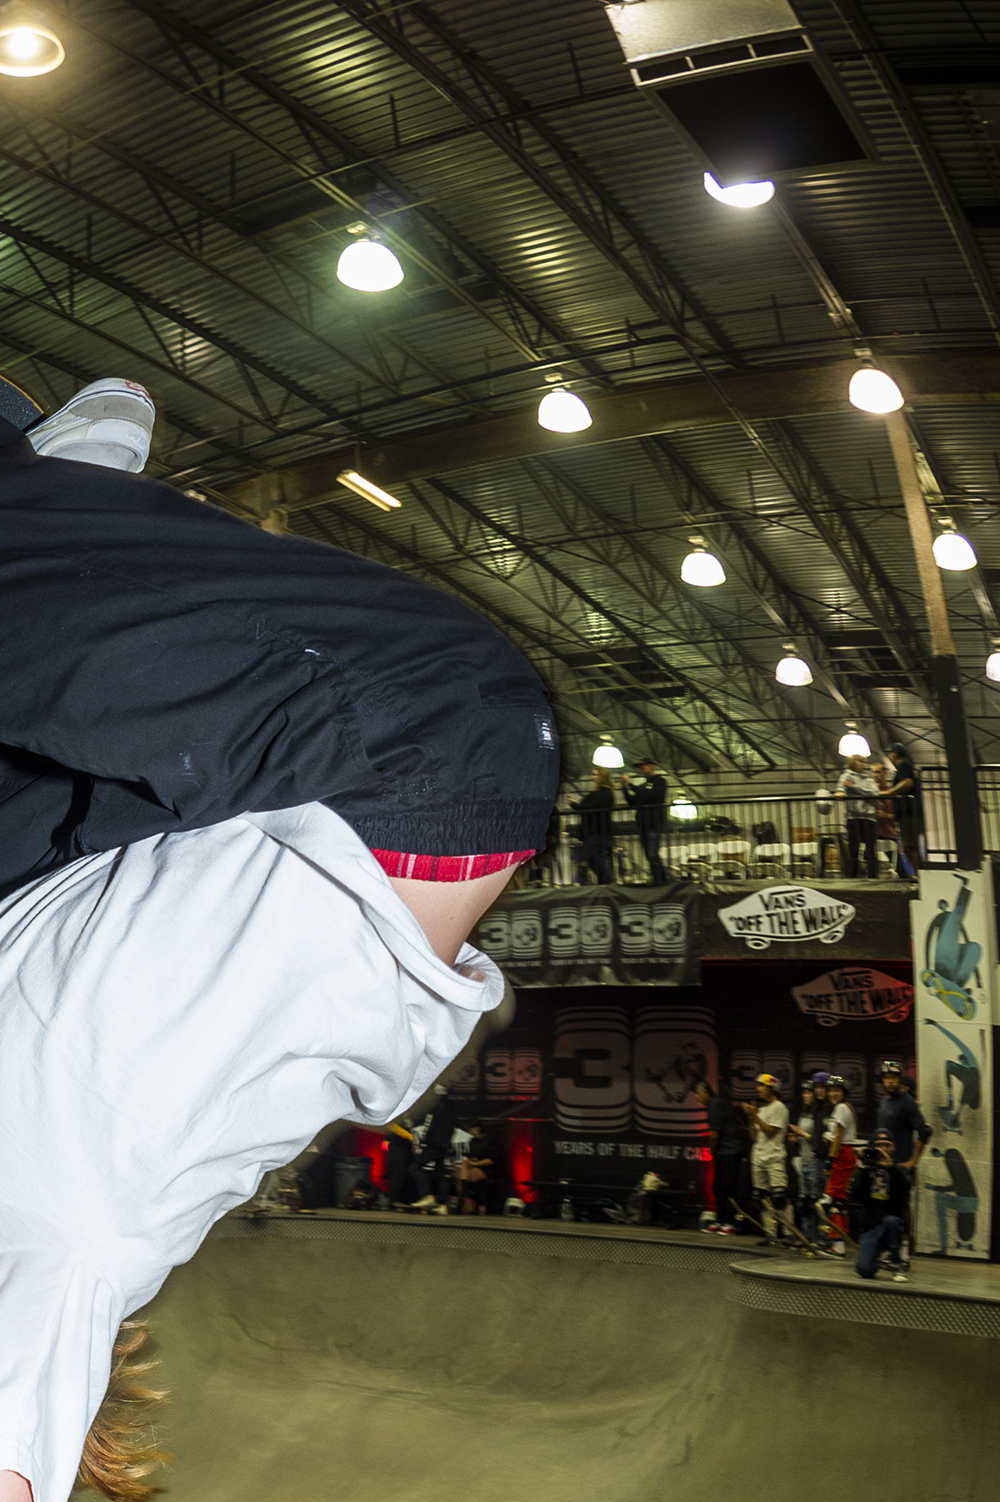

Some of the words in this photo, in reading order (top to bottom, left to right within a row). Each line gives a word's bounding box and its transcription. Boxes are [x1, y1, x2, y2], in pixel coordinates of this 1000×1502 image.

[758, 889, 806, 911] VANS
[766, 910, 801, 935] THE
[828, 970, 873, 991] VANS
[836, 991, 868, 1014] THE
[553, 1141, 596, 1156] YEARS
[596, 1143, 616, 1157] OF
[618, 1144, 646, 1158] THE
[646, 1145, 682, 1160] HALF
